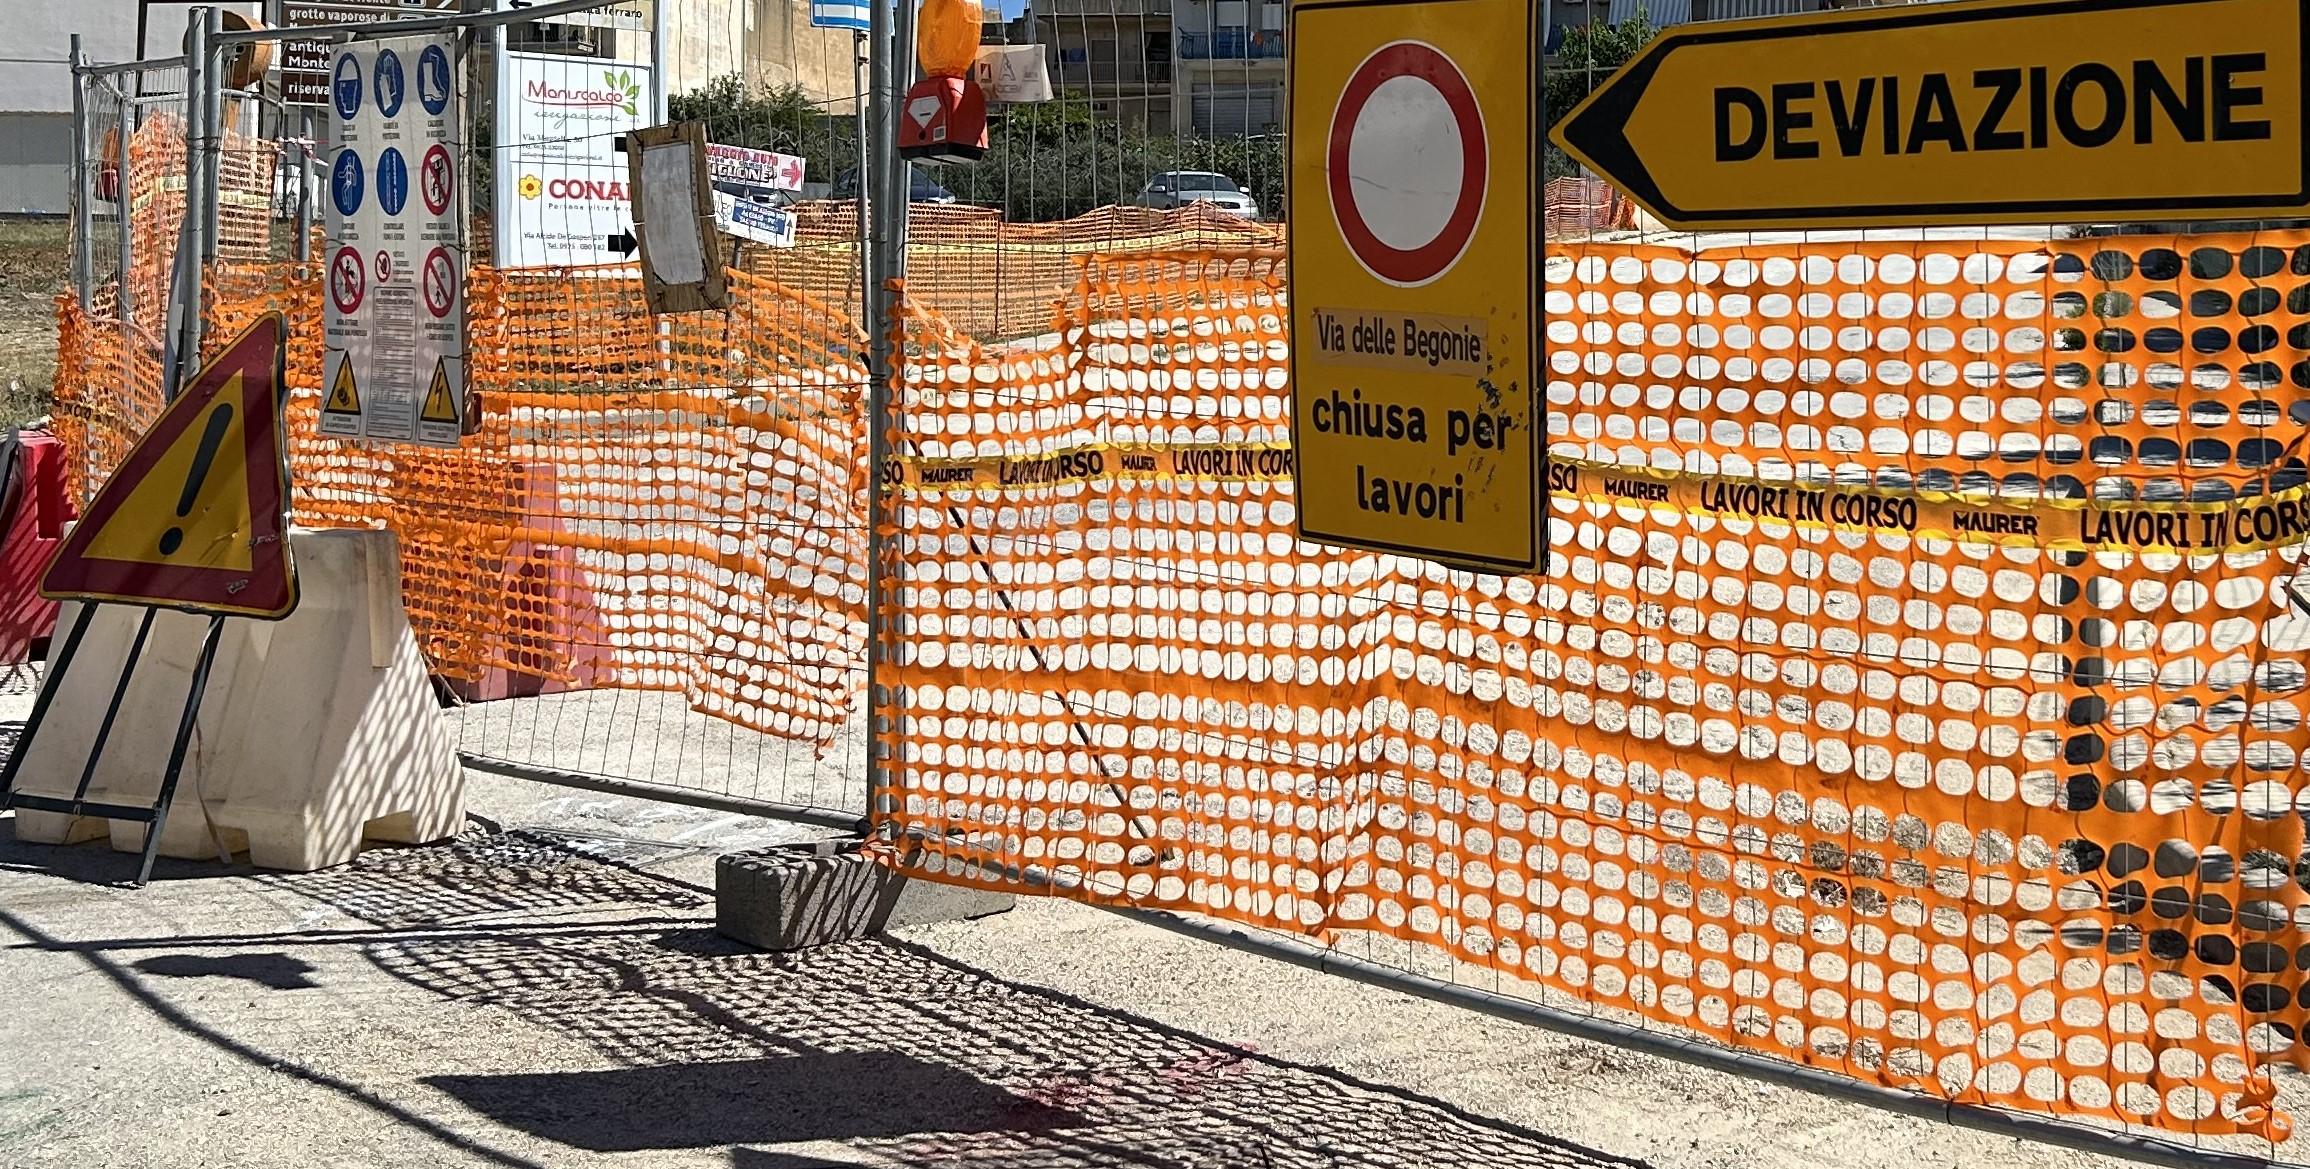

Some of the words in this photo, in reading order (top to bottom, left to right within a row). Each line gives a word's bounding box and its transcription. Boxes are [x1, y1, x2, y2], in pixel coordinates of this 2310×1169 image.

[290, 8, 326, 20] grotte
[327, 10, 377, 22] vaporose
[380, 12, 391, 21] di
[1713, 53, 2272, 162] DEVIAZIONE
[548, 179, 632, 202] CONA
[1317, 317, 1345, 351] Via
[1352, 317, 1396, 355] delle
[1404, 319, 1481, 367] Begonie
[1312, 388, 1428, 444] chiusa
[1448, 409, 1512, 456] per
[881, 459, 905, 485] SO
[921, 467, 974, 483] MAURER
[1173, 449, 1234, 476] LAVORI
[1235, 449, 1256, 477] IN
[1356, 464, 1465, 523] lavori
[1603, 477, 1670, 502] MAURER
[1701, 480, 1789, 519] LAVORI
[1796, 488, 1825, 523] IN
[1830, 492, 1918, 531] CORSO
[1953, 510, 2038, 536] MAURER
[2080, 508, 2190, 548] LAVORI
[2200, 508, 2228, 548] IN
